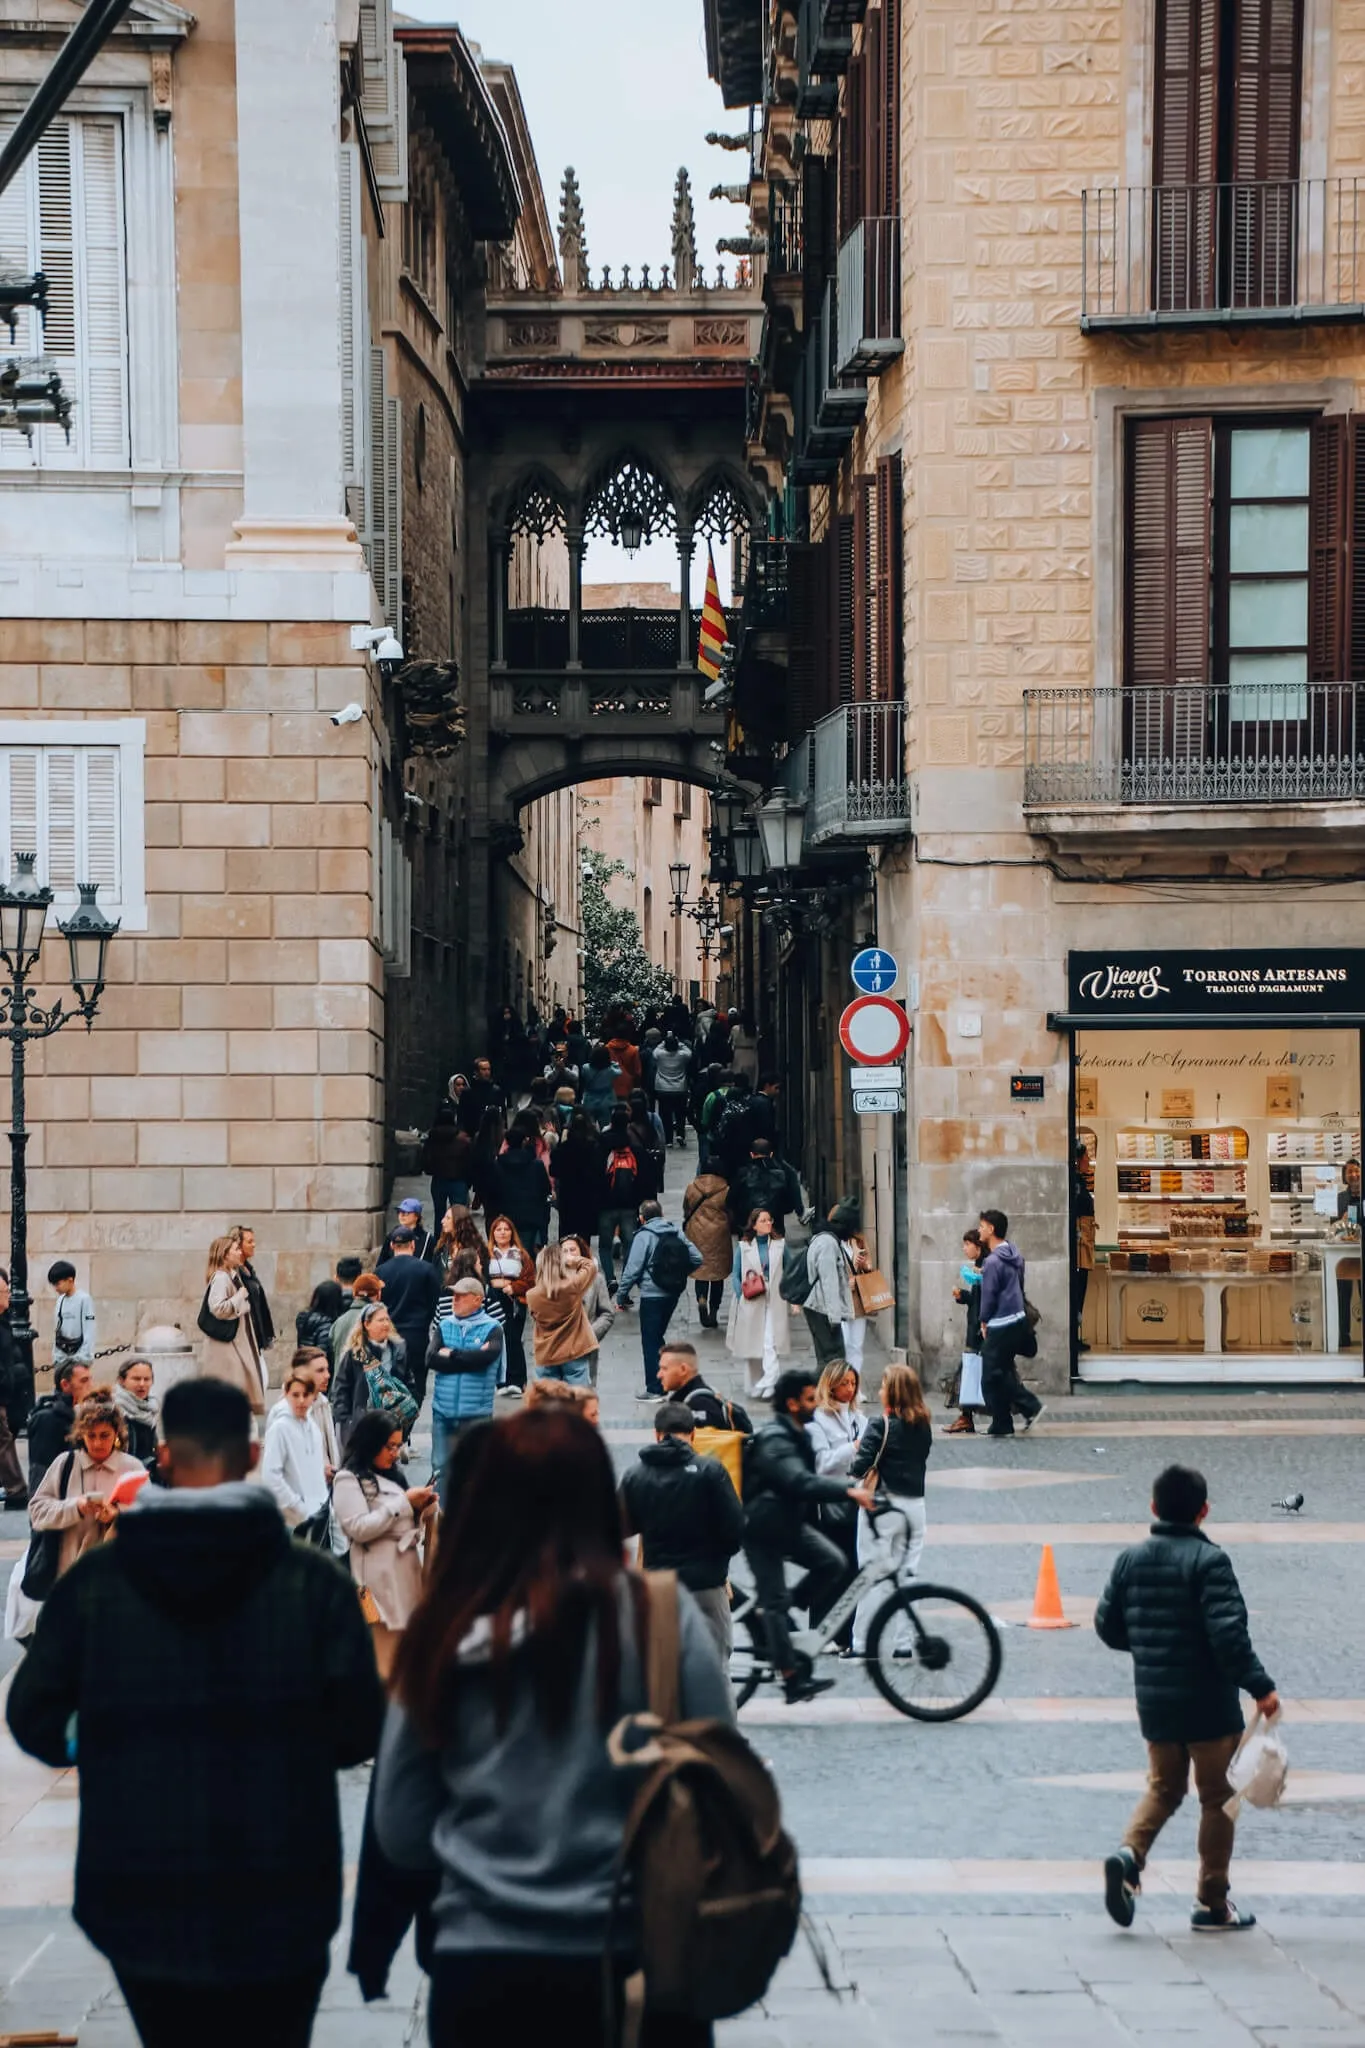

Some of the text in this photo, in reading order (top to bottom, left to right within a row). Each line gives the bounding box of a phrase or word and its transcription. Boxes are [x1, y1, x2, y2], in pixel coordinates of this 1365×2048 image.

[1182, 967, 1347, 982] TORRONS ARTESANS
[1079, 965, 1171, 999] Vicens
[1110, 989, 1135, 999] 1775
[1206, 984, 1257, 993] TRADICIÓ
